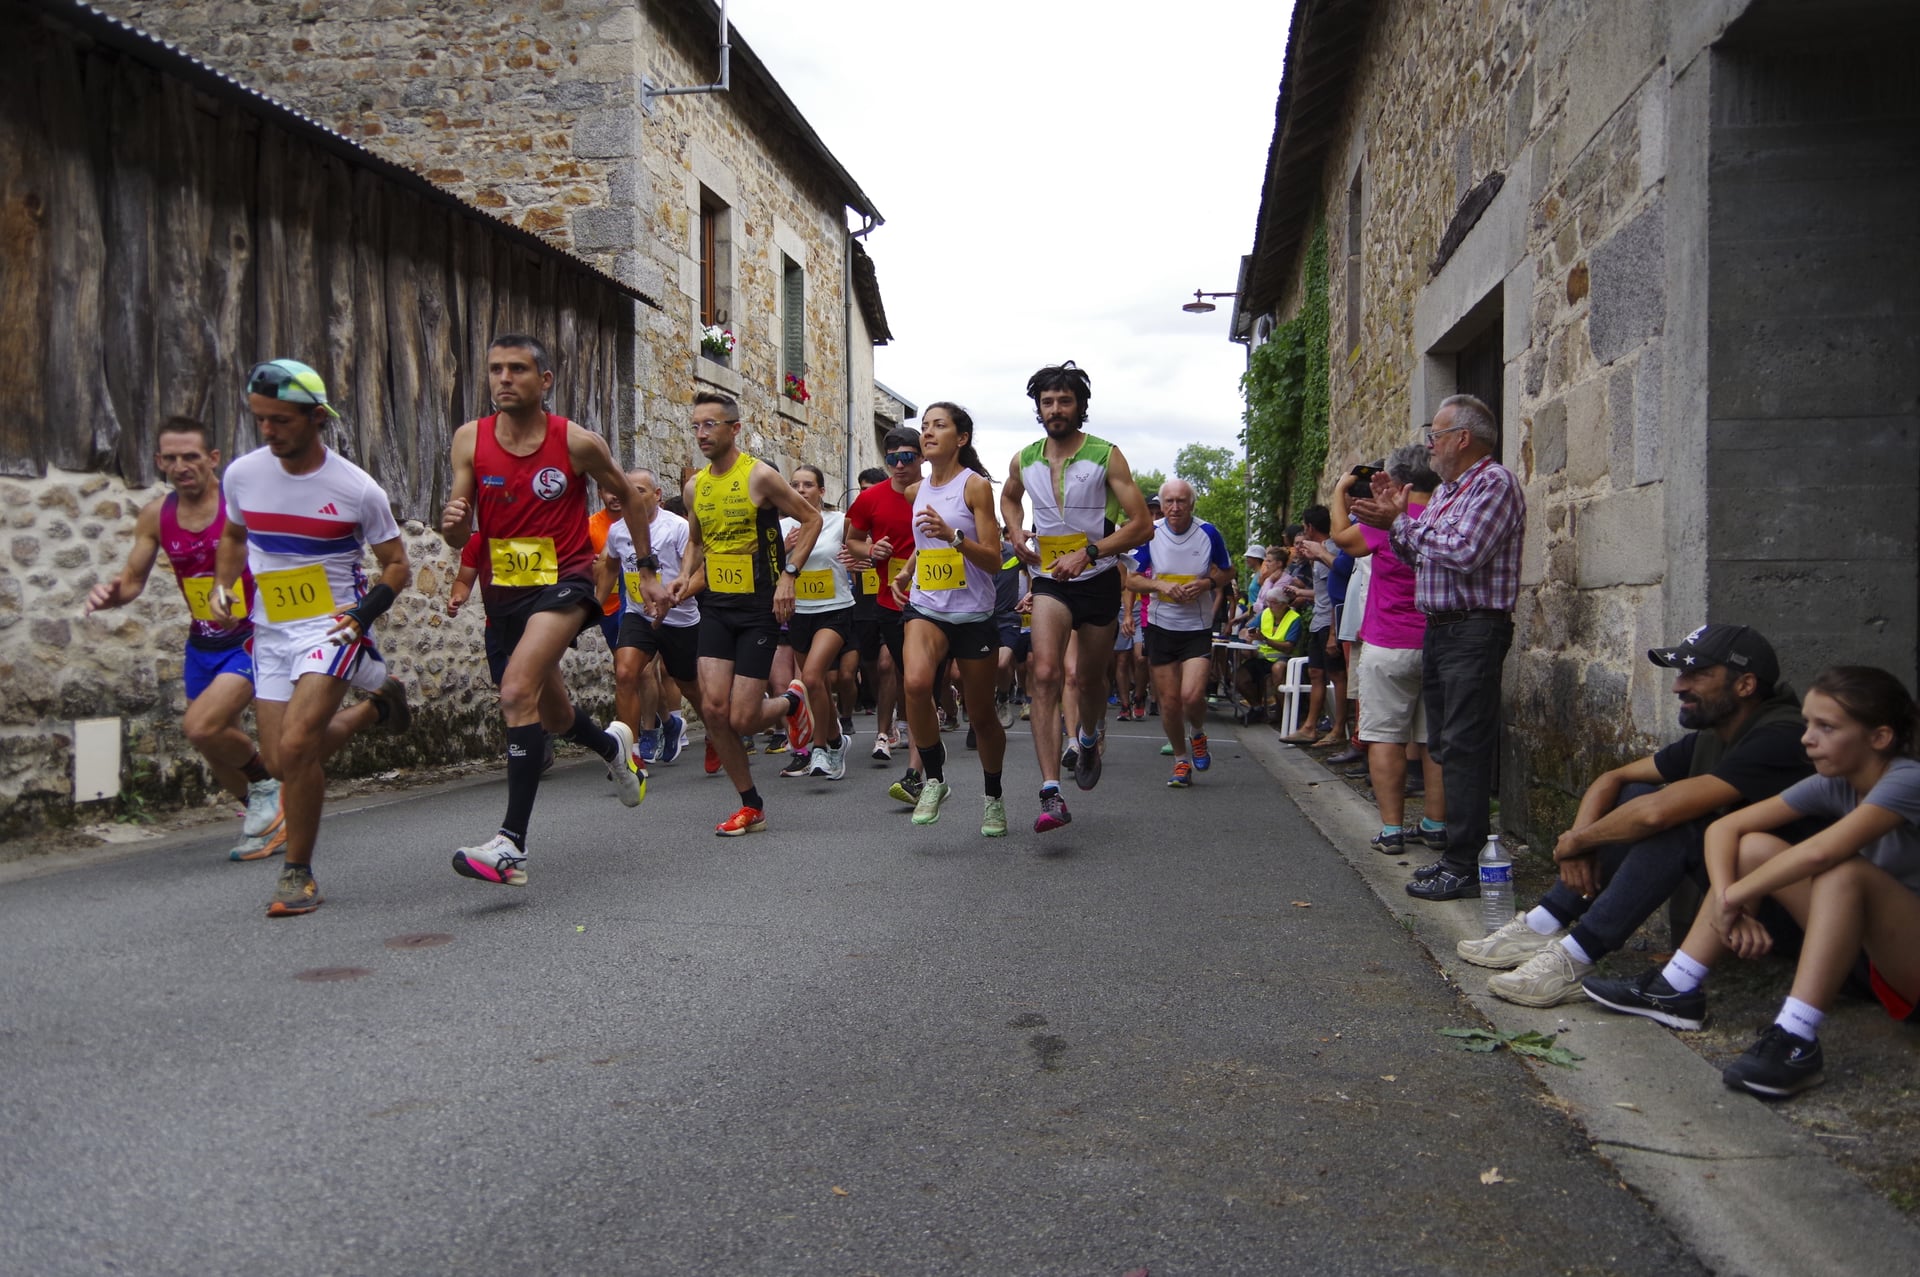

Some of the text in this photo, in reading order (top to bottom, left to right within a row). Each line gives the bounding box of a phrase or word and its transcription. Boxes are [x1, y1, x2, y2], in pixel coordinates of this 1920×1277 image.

[503, 551, 542, 573] 302
[715, 567, 743, 585] 305
[924, 563, 953, 581] 309
[272, 582, 316, 608] 310
[802, 581, 825, 594] 102
